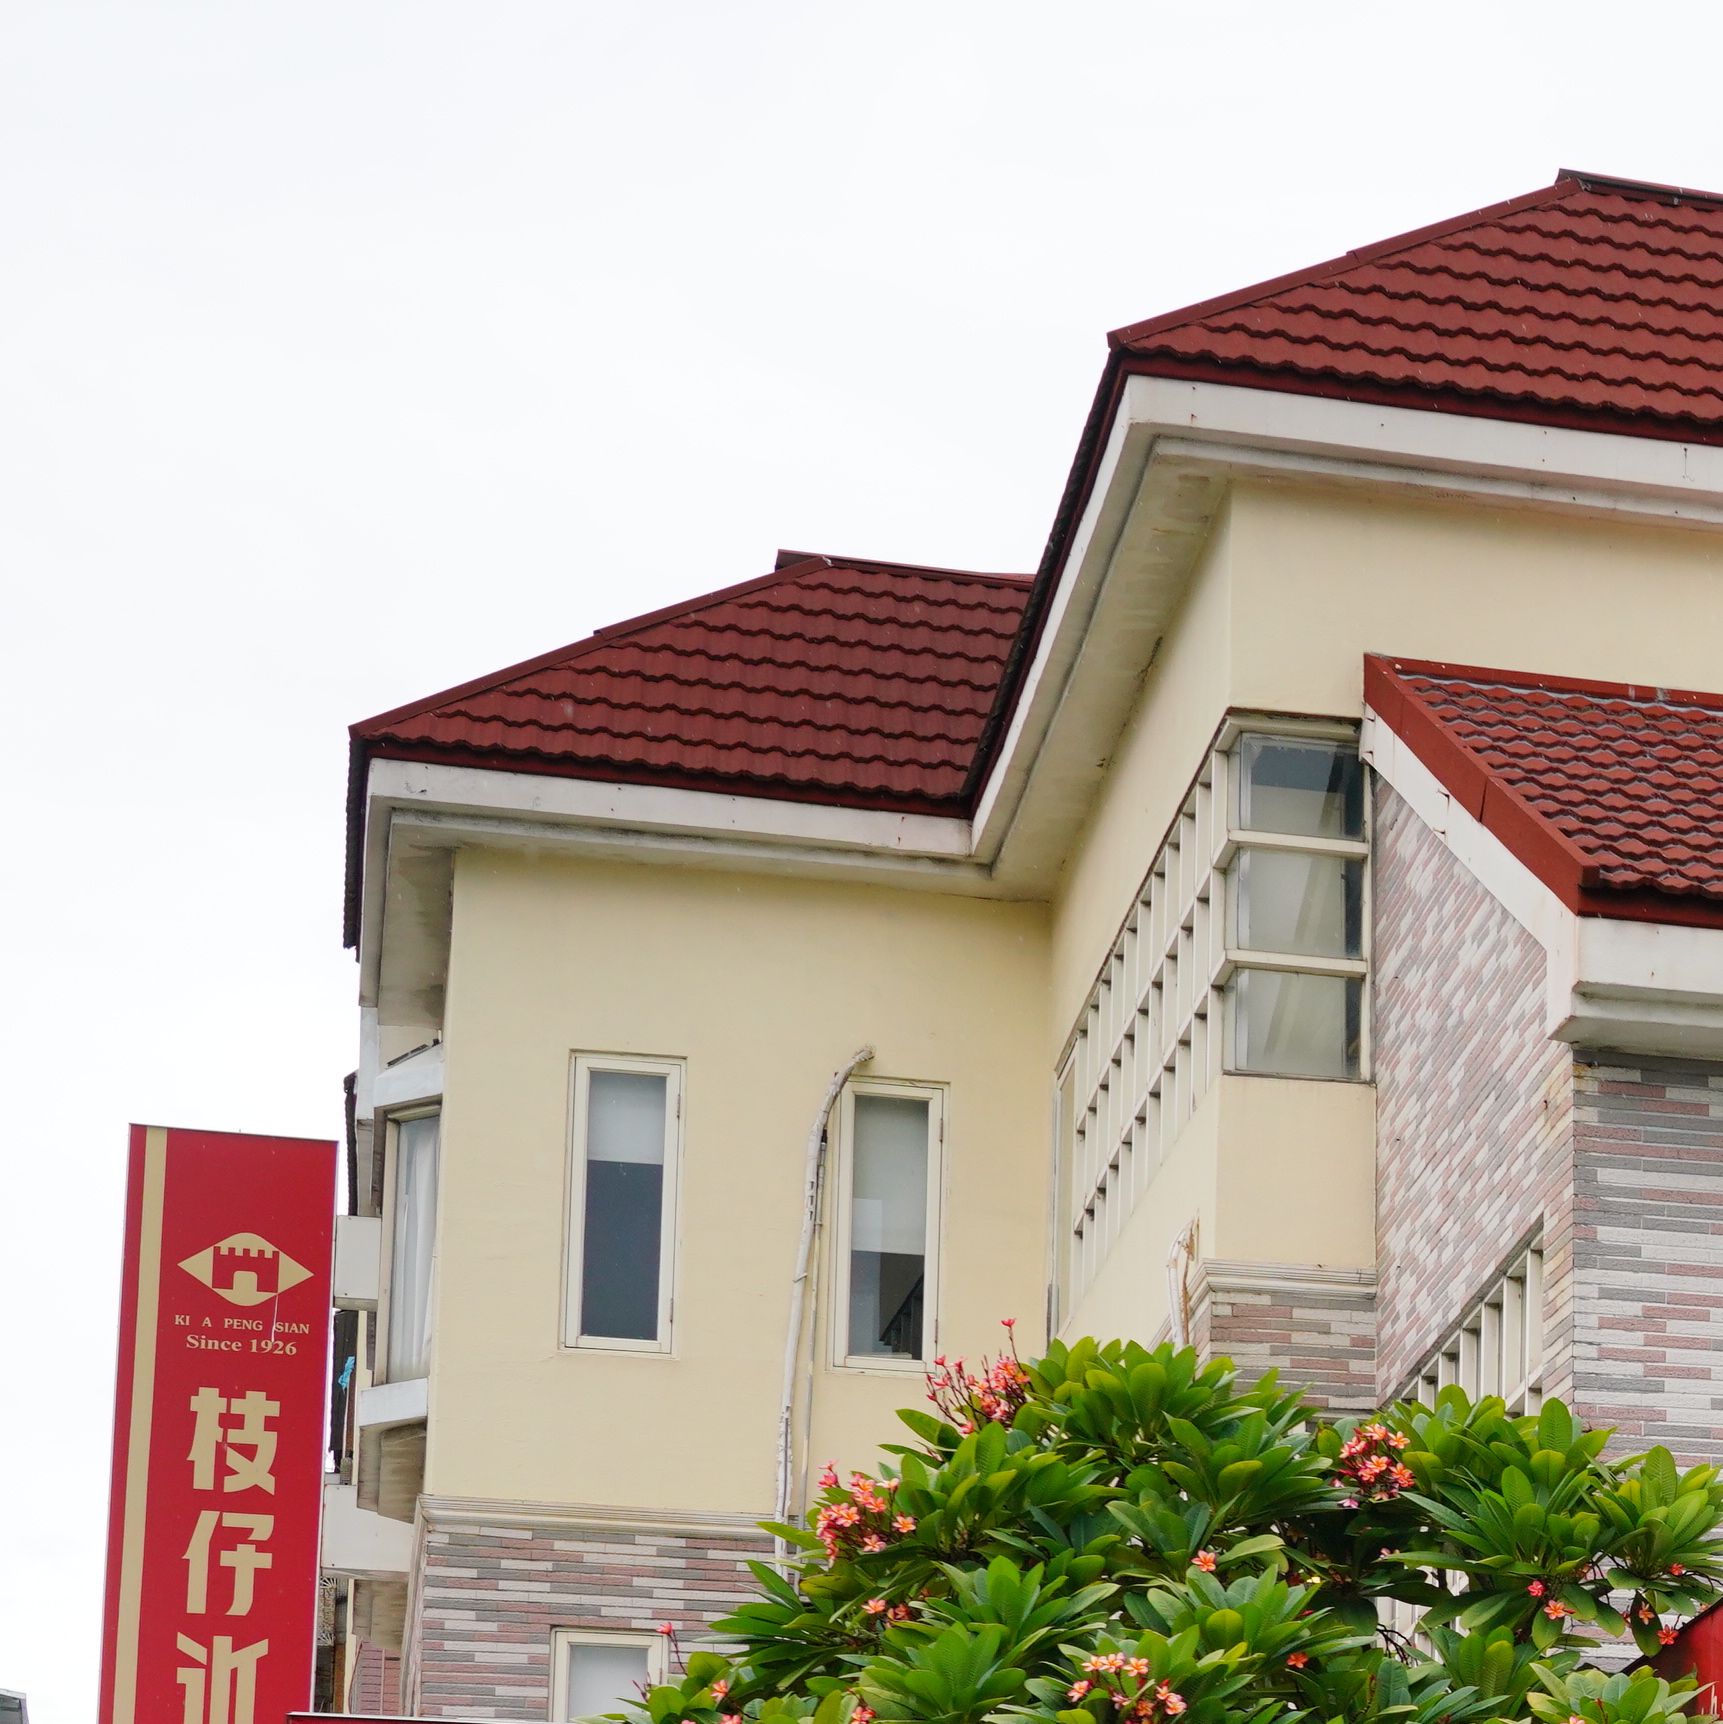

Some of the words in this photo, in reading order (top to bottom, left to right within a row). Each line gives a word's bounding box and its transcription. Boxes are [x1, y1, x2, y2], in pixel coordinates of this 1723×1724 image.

[175, 1314, 191, 1326] KI
[202, 1316, 212, 1328] A
[224, 1318, 263, 1331] PENG
[274, 1321, 310, 1334] SIAN
[186, 1334, 242, 1351] Since
[250, 1339, 298, 1356] 1926
